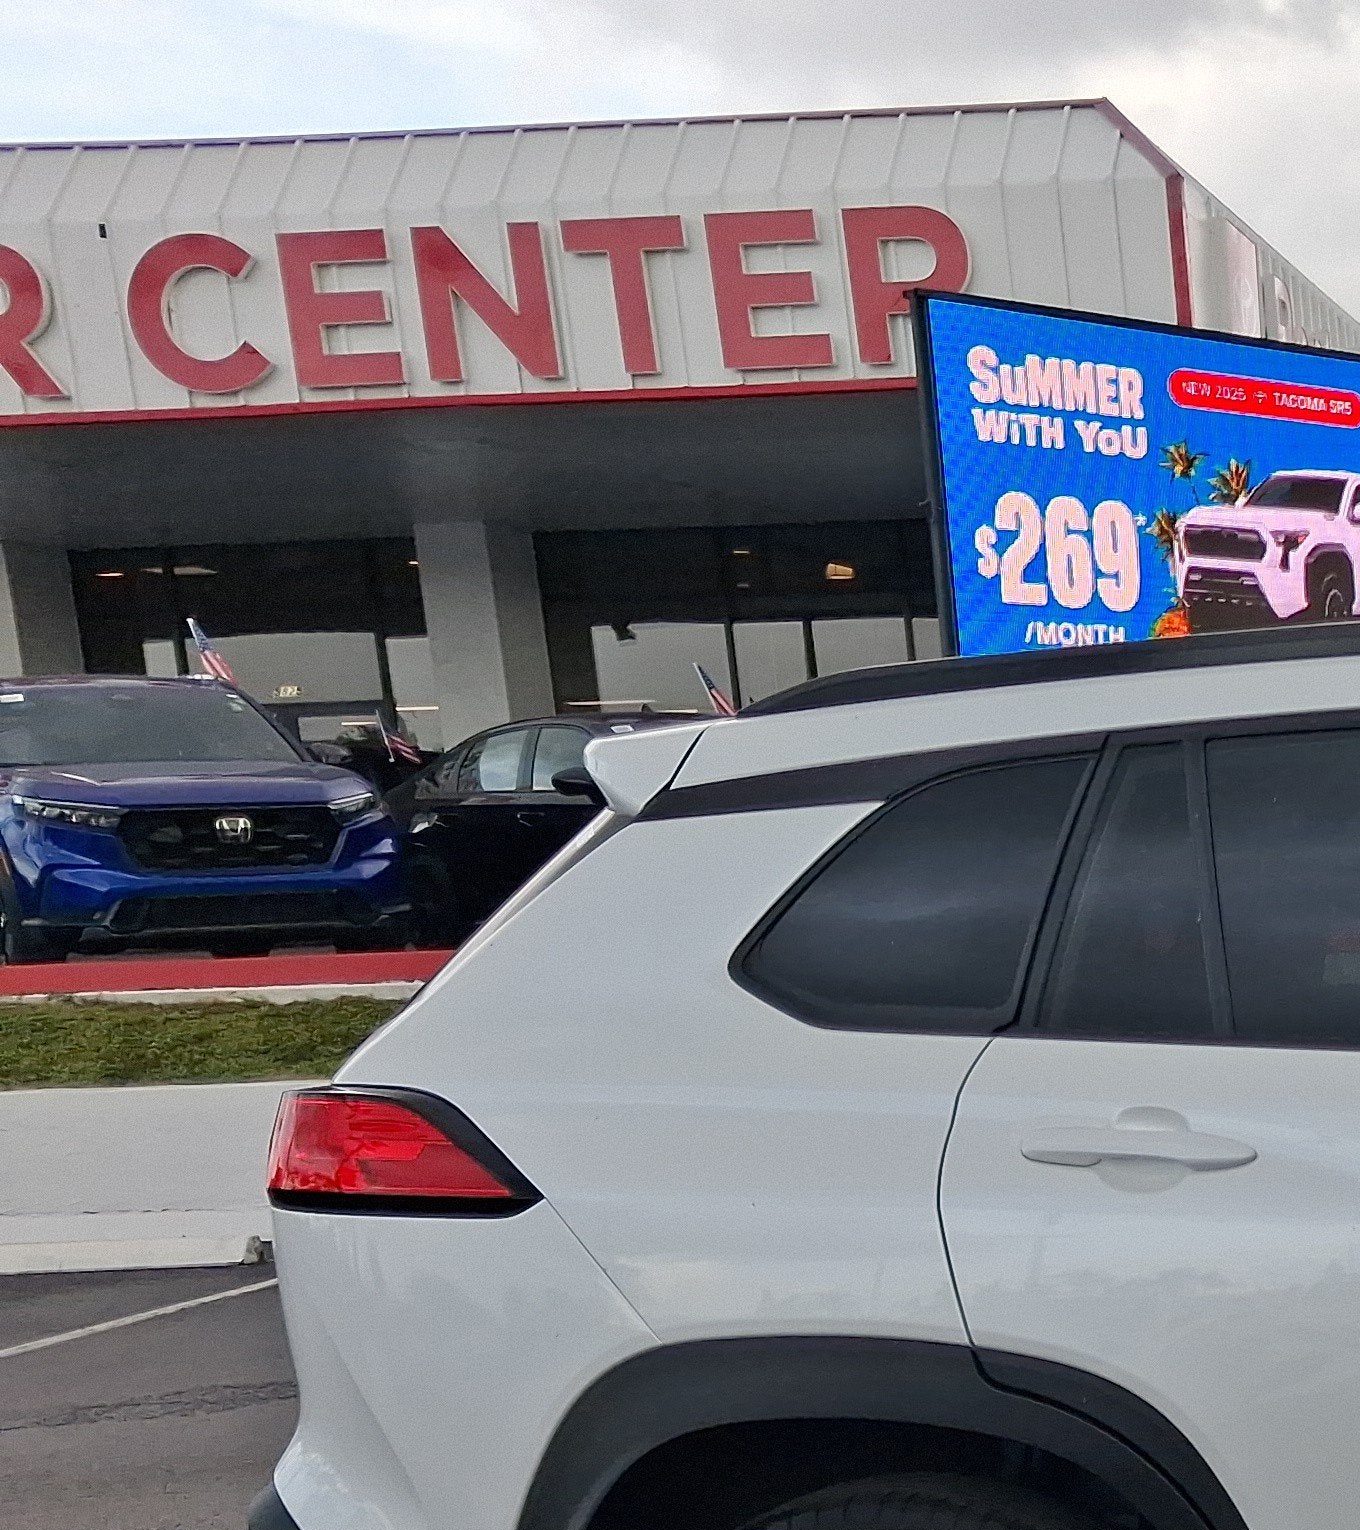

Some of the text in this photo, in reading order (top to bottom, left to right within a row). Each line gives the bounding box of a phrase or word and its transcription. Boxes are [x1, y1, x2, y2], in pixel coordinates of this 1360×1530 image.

[127, 206, 972, 394] CENTER
[1181, 380, 1212, 398] NEW
[1272, 391, 1328, 412] TACOMA
[1329, 399, 1353, 416] SR5
[1024, 620, 1127, 647] /MONTH
